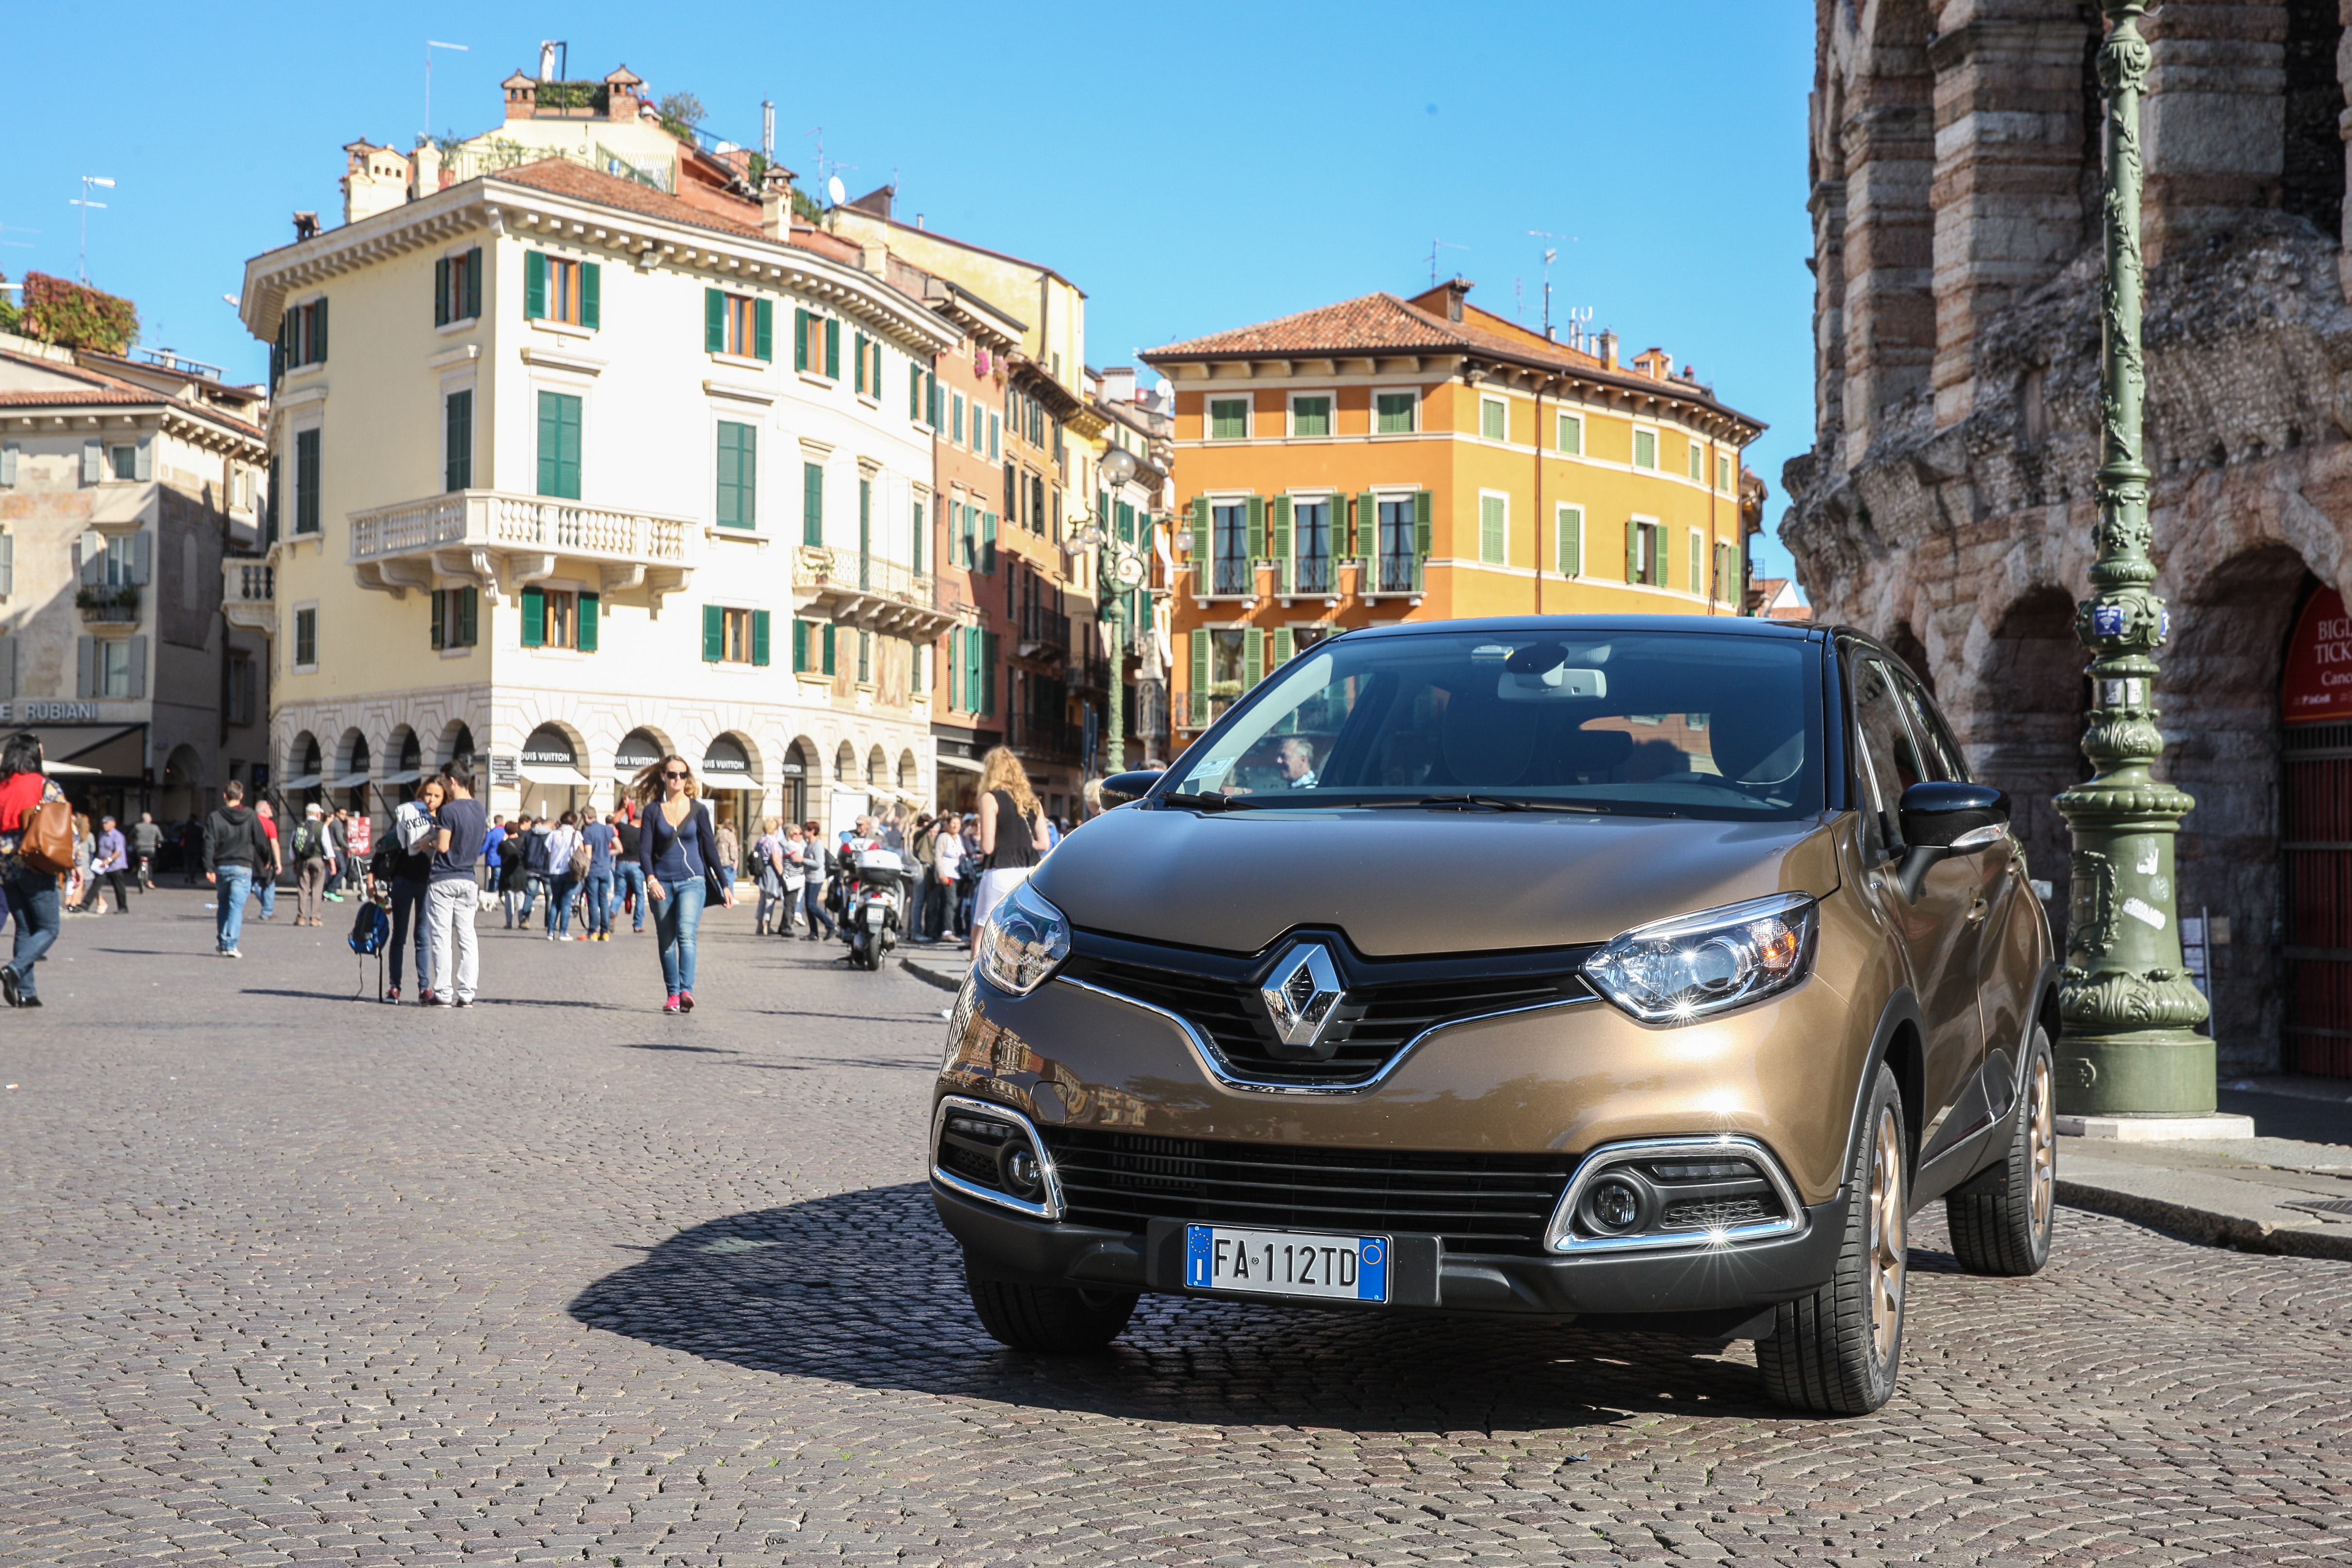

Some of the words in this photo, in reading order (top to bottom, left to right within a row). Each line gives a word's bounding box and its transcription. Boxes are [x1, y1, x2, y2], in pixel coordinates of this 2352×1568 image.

[2314, 641, 2352, 664] TICK
[2321, 670, 2352, 687] Canc
[26, 704, 97, 720] RUBIANI
[538, 752, 570, 762] VUITTON
[716, 760, 745, 769] VUITTON
